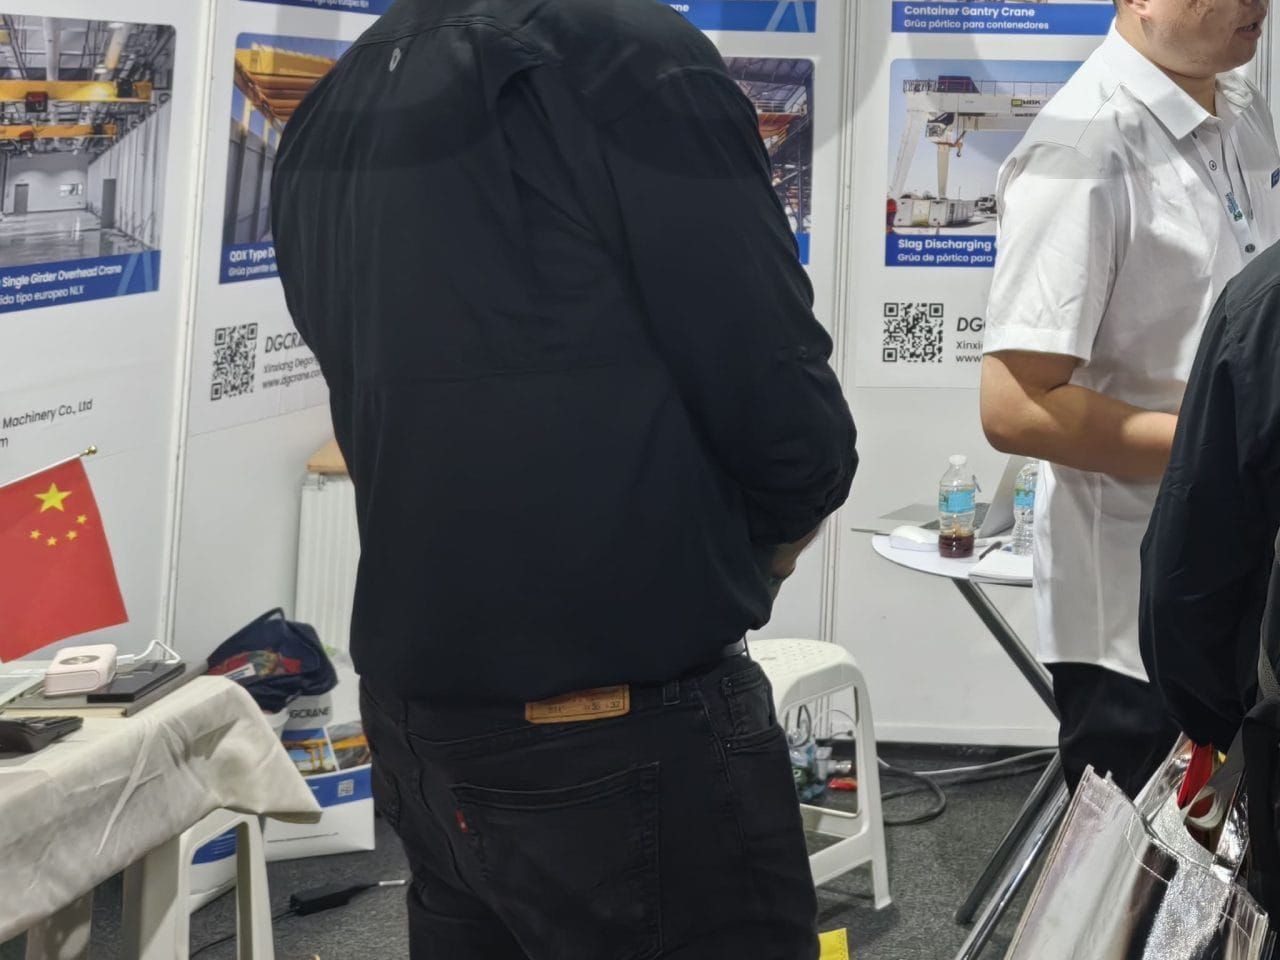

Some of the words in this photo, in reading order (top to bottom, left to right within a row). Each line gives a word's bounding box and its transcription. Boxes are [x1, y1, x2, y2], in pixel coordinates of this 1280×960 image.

[904, 5, 960, 16] Container
[961, 6, 999, 19] Gantry
[1001, 7, 1035, 17] Crane
[904, 19, 927, 28] Grúa
[928, 19, 961, 30] pórtico
[962, 21, 985, 30] para
[986, 21, 1049, 30] contenedores
[898, 239, 923, 251] Slag
[925, 239, 992, 252] Discharging
[249, 248, 268, 263] Type
[897, 253, 920, 262] Grúa
[922, 253, 935, 262] de
[936, 253, 969, 264] pórtico
[970, 255, 993, 263] para
[2, 274, 29, 289] Single
[30, 272, 57, 284] Girder
[58, 267, 98, 281] Overhead
[98, 265, 122, 275] Crane
[246, 264, 269, 277] puente
[16, 292, 33, 305] tipo
[34, 288, 69, 302] europeo
[264, 361, 294, 374] Xinxiang
[2, 408, 57, 429] Machinery
[58, 404, 76, 417] Co.,
[78, 398, 93, 413] Ltd
